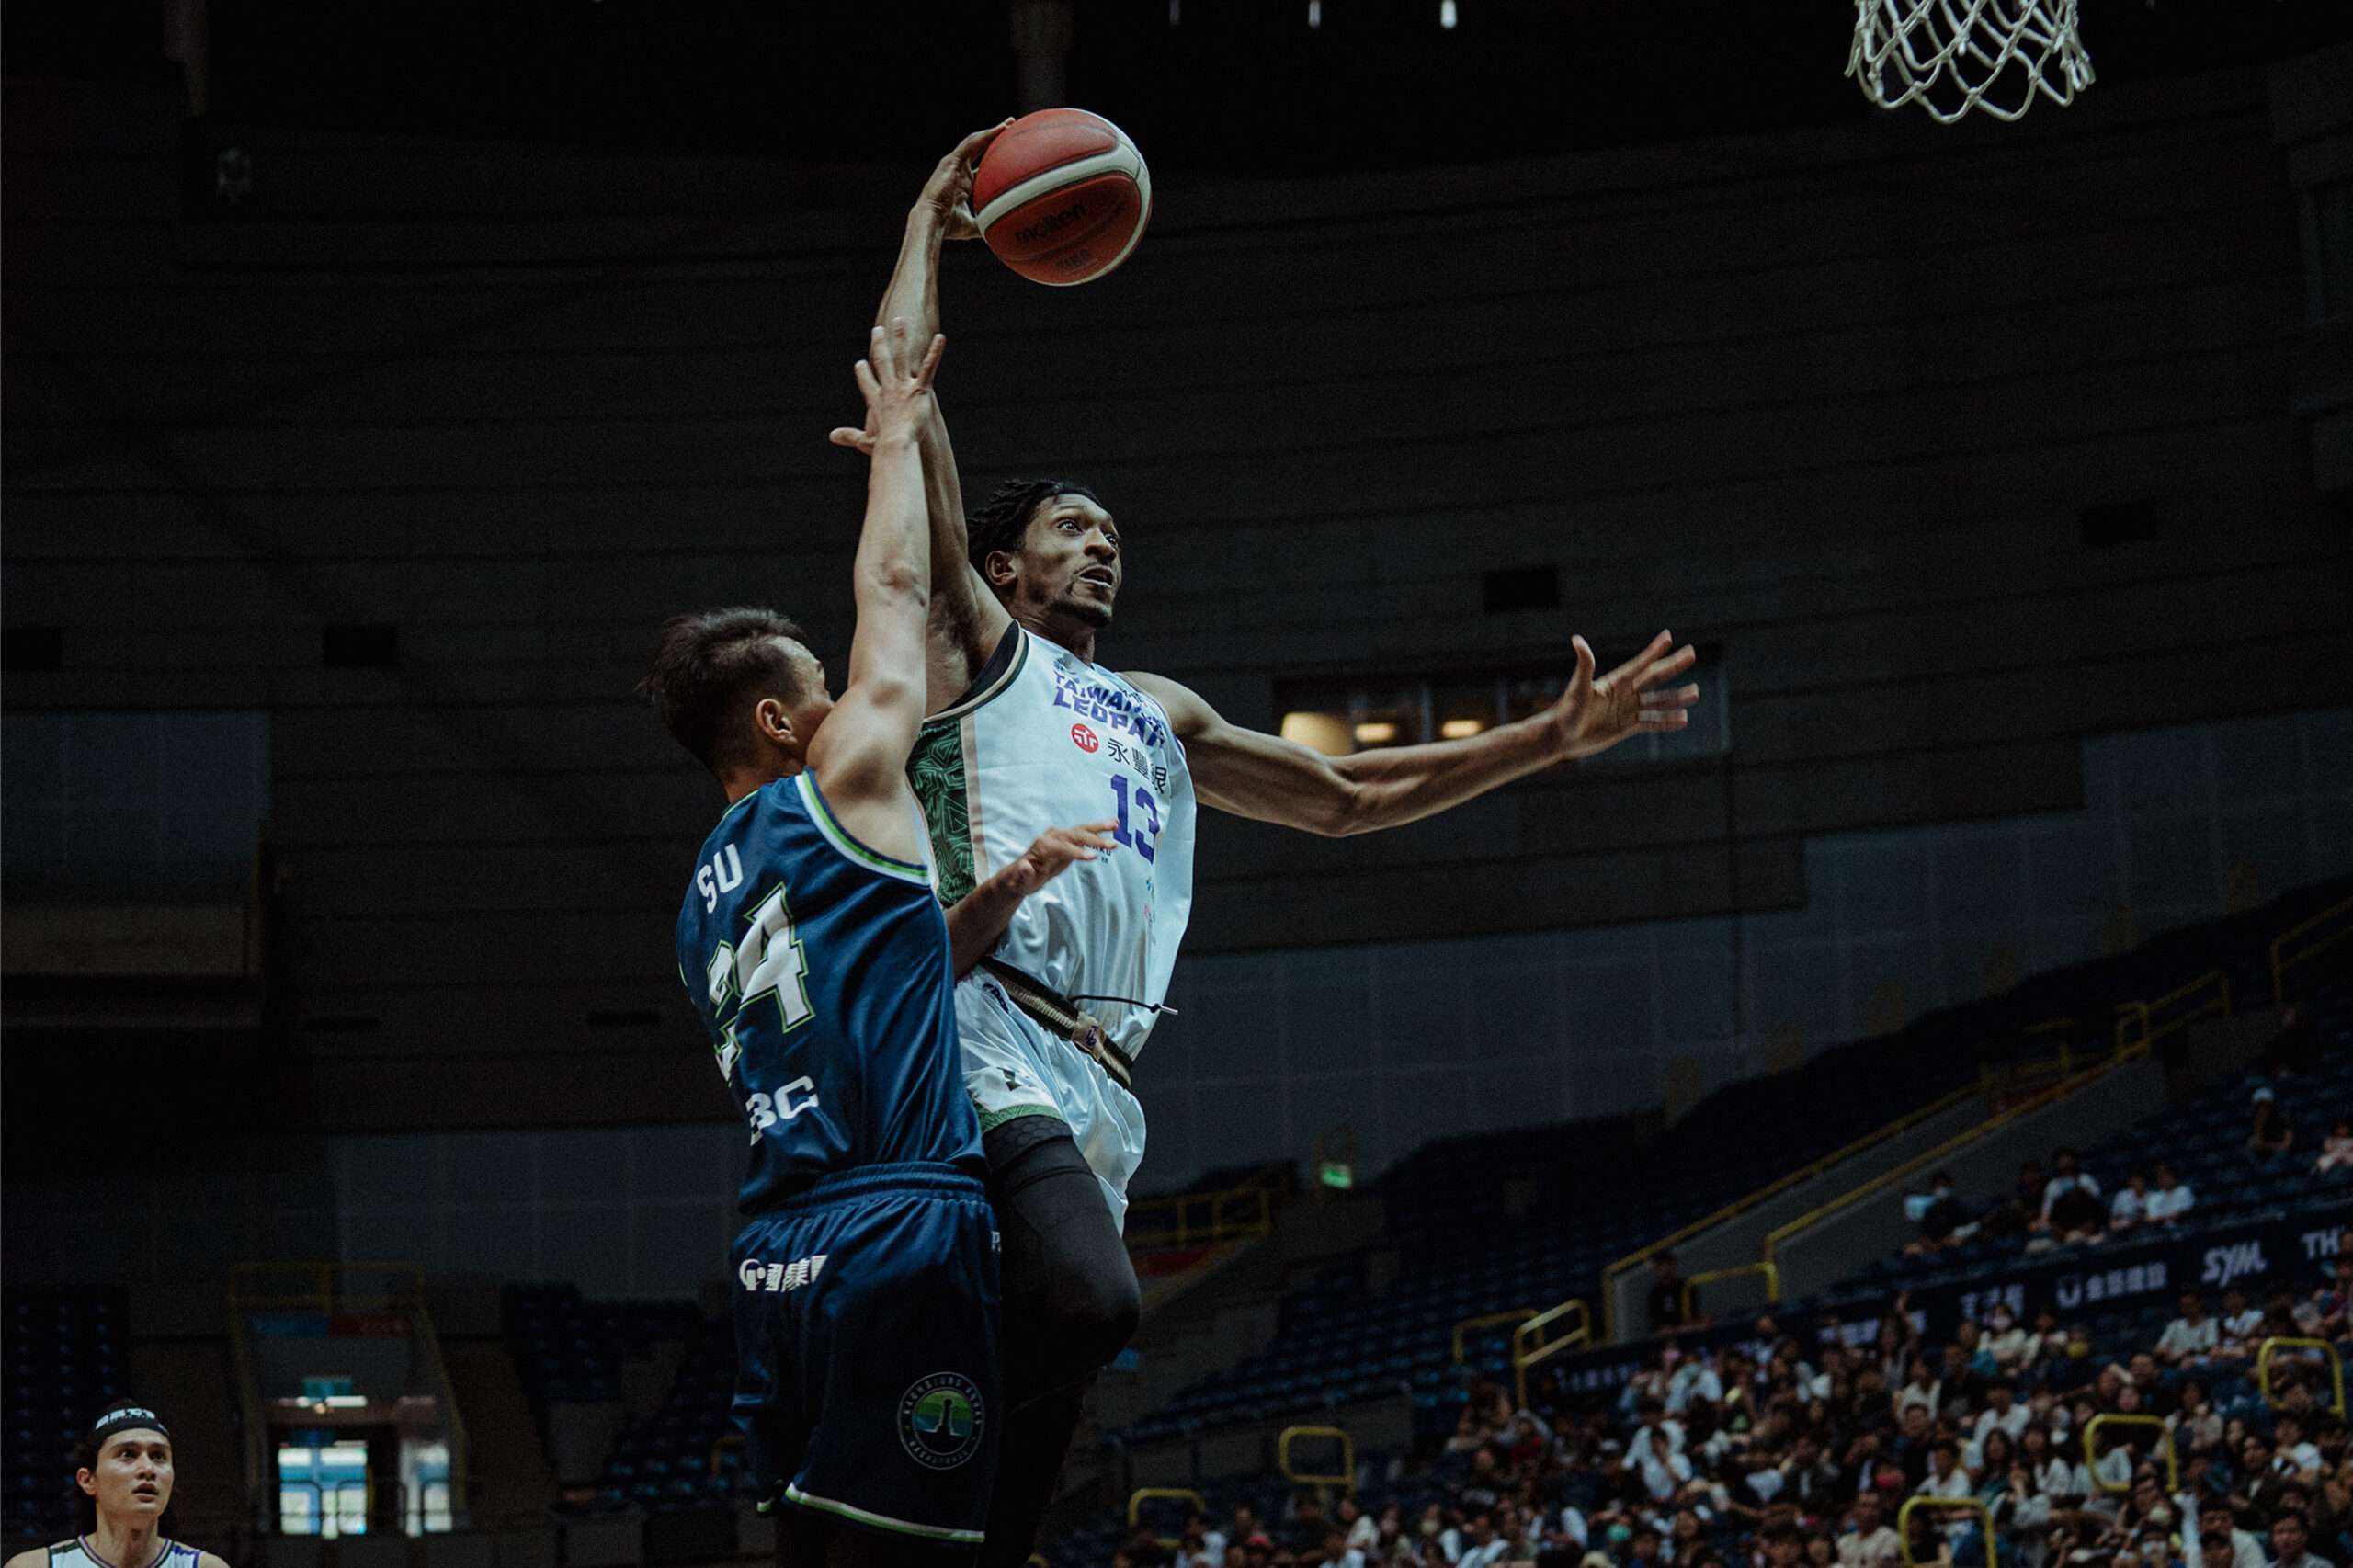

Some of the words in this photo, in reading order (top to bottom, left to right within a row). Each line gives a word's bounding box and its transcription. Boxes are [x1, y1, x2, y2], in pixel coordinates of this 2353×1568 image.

[1110, 774, 1160, 866] 13
[696, 843, 744, 914] SU
[2200, 1239, 2267, 1287] SYM
[2300, 1228, 2341, 1260] TH
